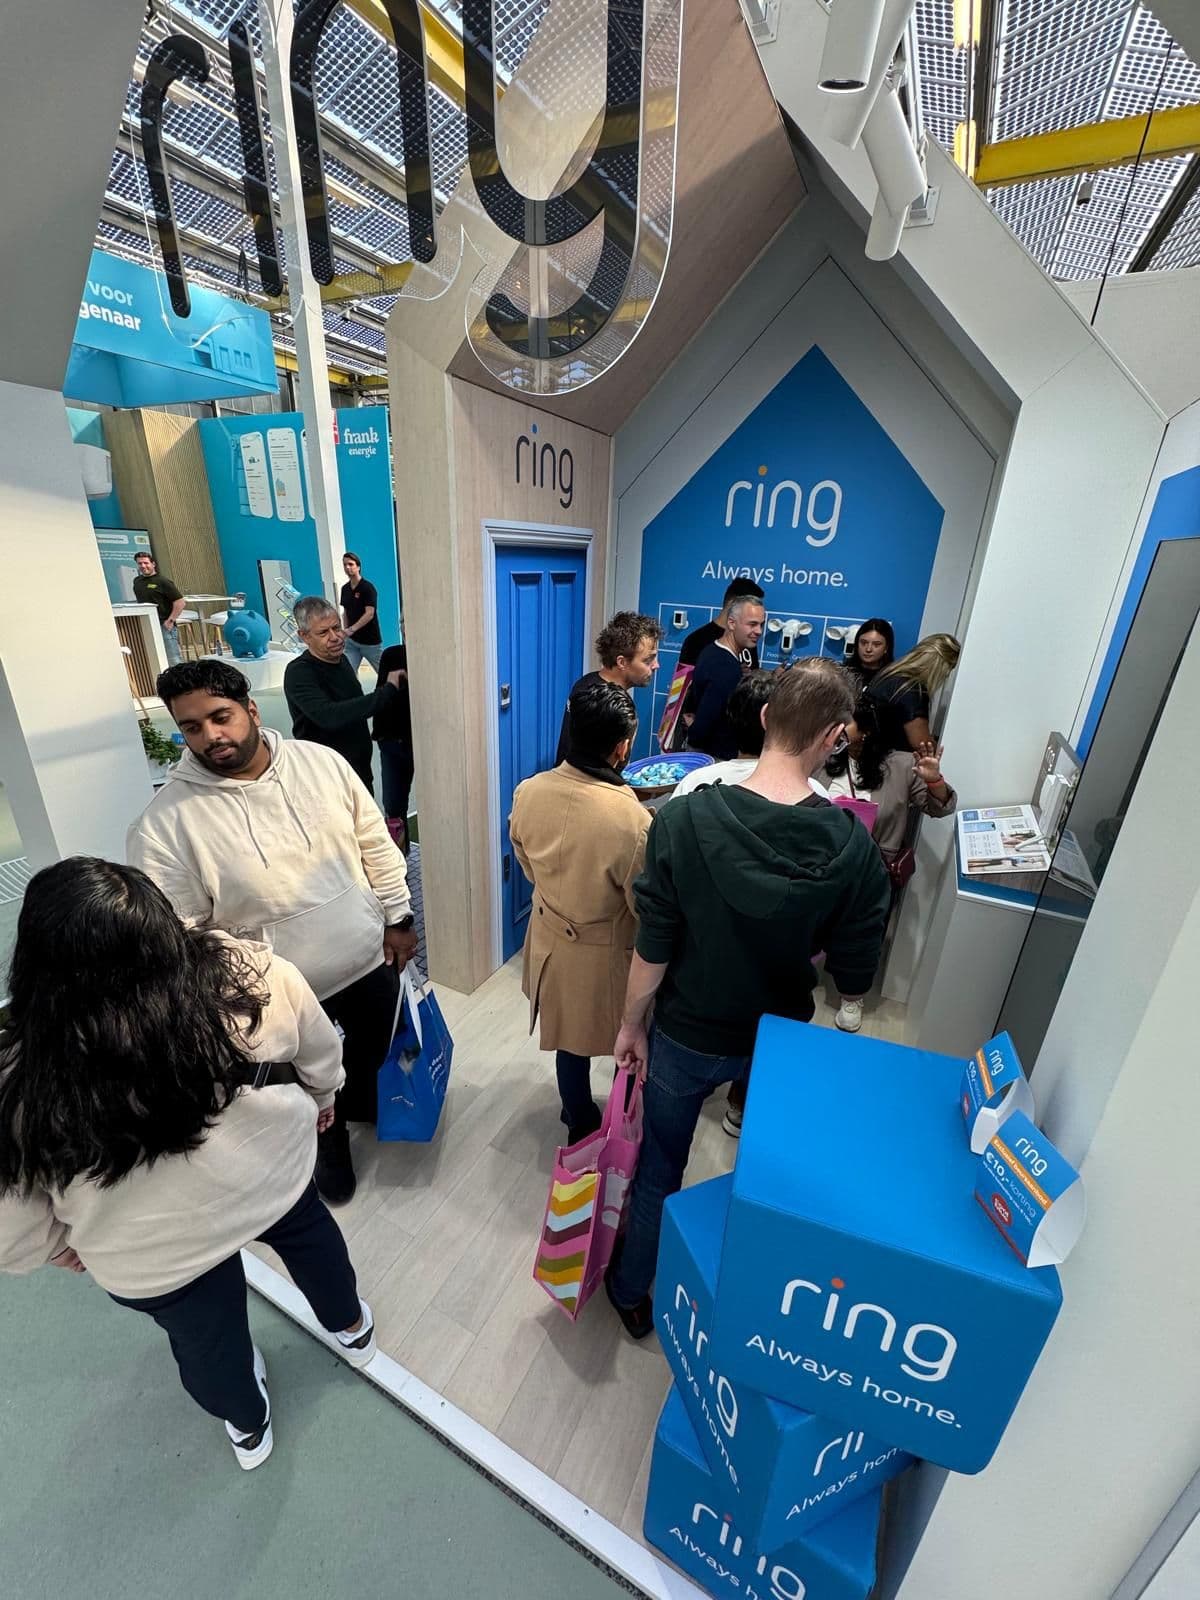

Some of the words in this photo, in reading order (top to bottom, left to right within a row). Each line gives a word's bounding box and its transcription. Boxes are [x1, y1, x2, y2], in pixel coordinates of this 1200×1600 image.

[87, 280, 133, 306] voor
[344, 427, 380, 444] frank
[348, 446, 377, 458] energie
[515, 423, 574, 510] ring
[725, 465, 843, 548] ring
[701, 560, 774, 584] Always
[780, 563, 849, 587] home.
[988, 1049, 1005, 1076] ring
[1015, 1137, 1048, 1176] ring
[1009, 1181, 1037, 1219] korting
[781, 1277, 958, 1382] ring
[663, 1312, 700, 1397] Always
[701, 1397, 741, 1495] home.
[745, 1334, 853, 1386] Always
[862, 1376, 963, 1428] home.
[813, 1431, 865, 1476] ri
[785, 1471, 858, 1520] Always
[668, 1527, 741, 1587] Always
